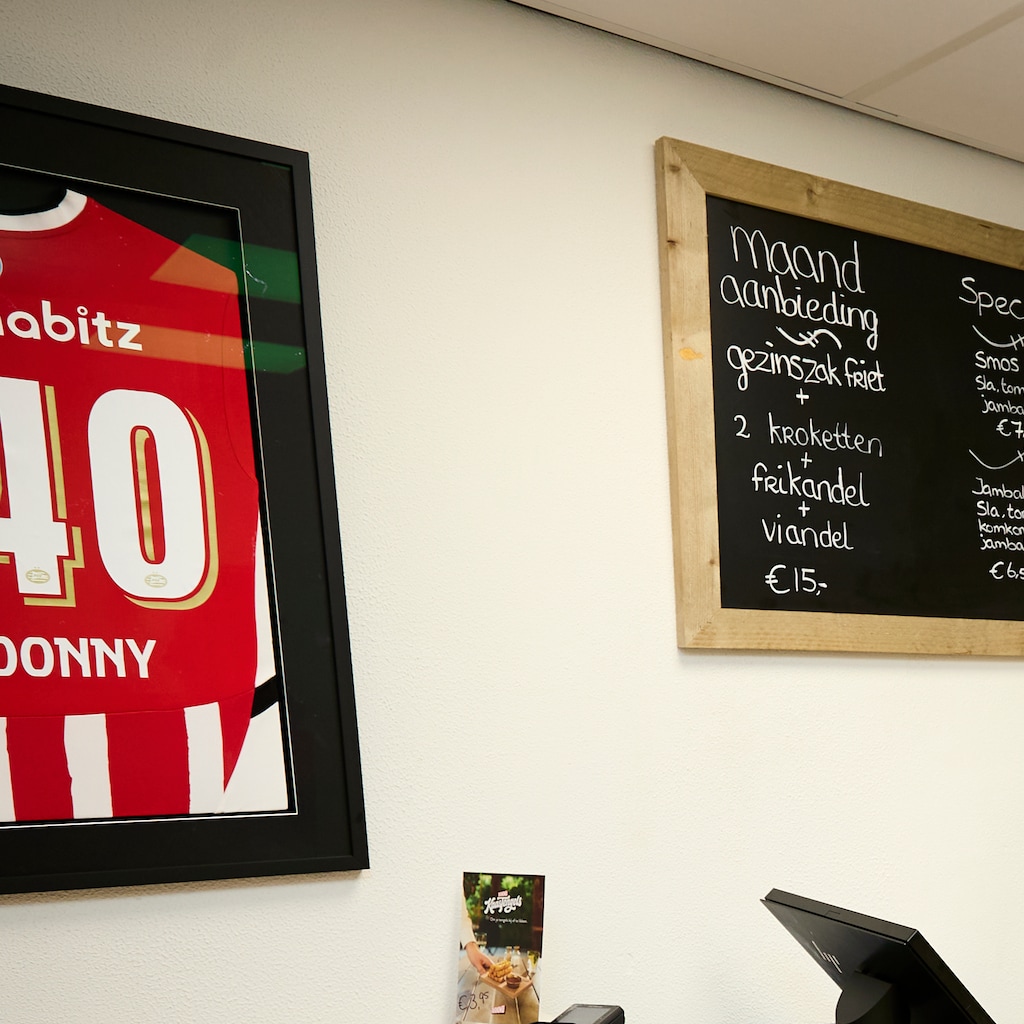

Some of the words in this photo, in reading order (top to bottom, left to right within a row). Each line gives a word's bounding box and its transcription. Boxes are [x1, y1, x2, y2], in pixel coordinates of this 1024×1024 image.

[0, 300, 143, 351] abitz
[720, 274, 879, 350] aanbieding
[726, 339, 842, 392] gezinszak
[844, 359, 886, 393] friet
[975, 351, 1019, 372] Smos
[734, 414, 750, 440] 2
[768, 412, 883, 457] kroketten
[752, 463, 871, 507] frikandel
[762, 513, 854, 551] viandel
